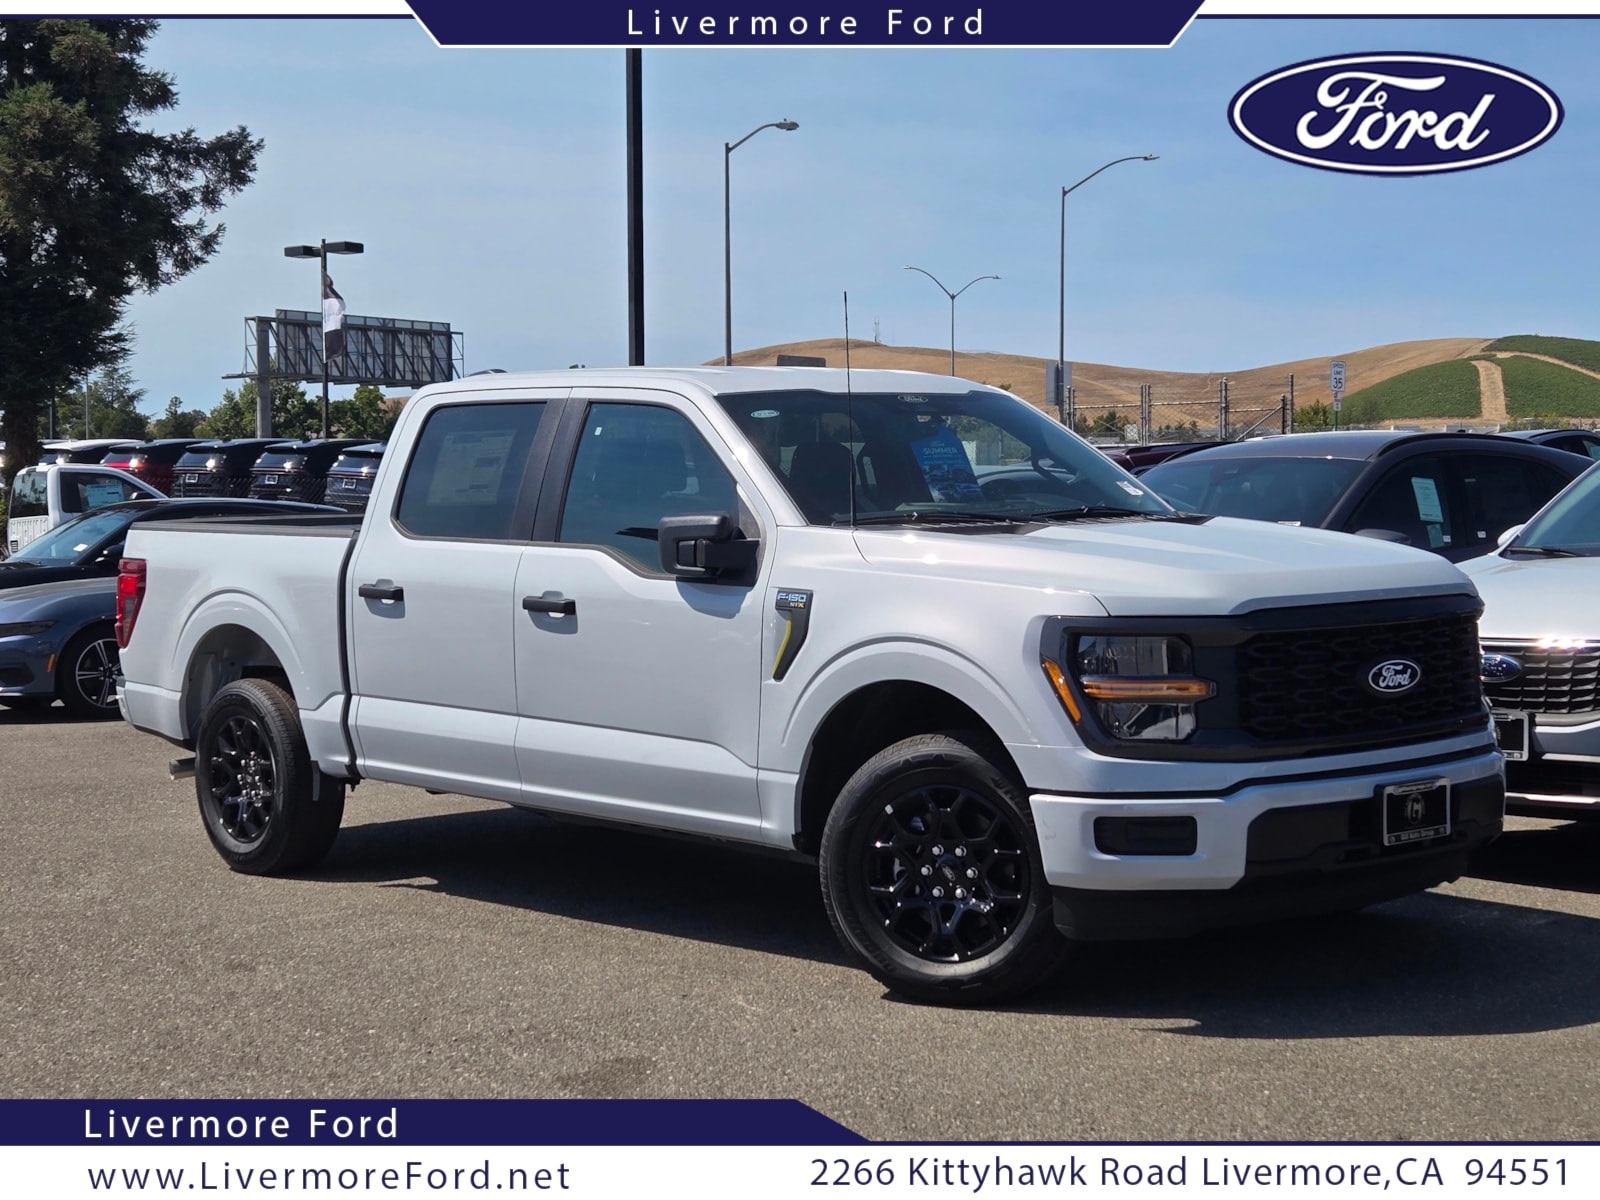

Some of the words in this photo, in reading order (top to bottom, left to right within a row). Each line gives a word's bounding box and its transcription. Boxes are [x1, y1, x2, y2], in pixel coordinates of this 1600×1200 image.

[1332, 377, 1343, 390] 35
[923, 447, 958, 455] SUMMER
[777, 592, 807, 603] F-150
[1378, 664, 1412, 688] Ford
